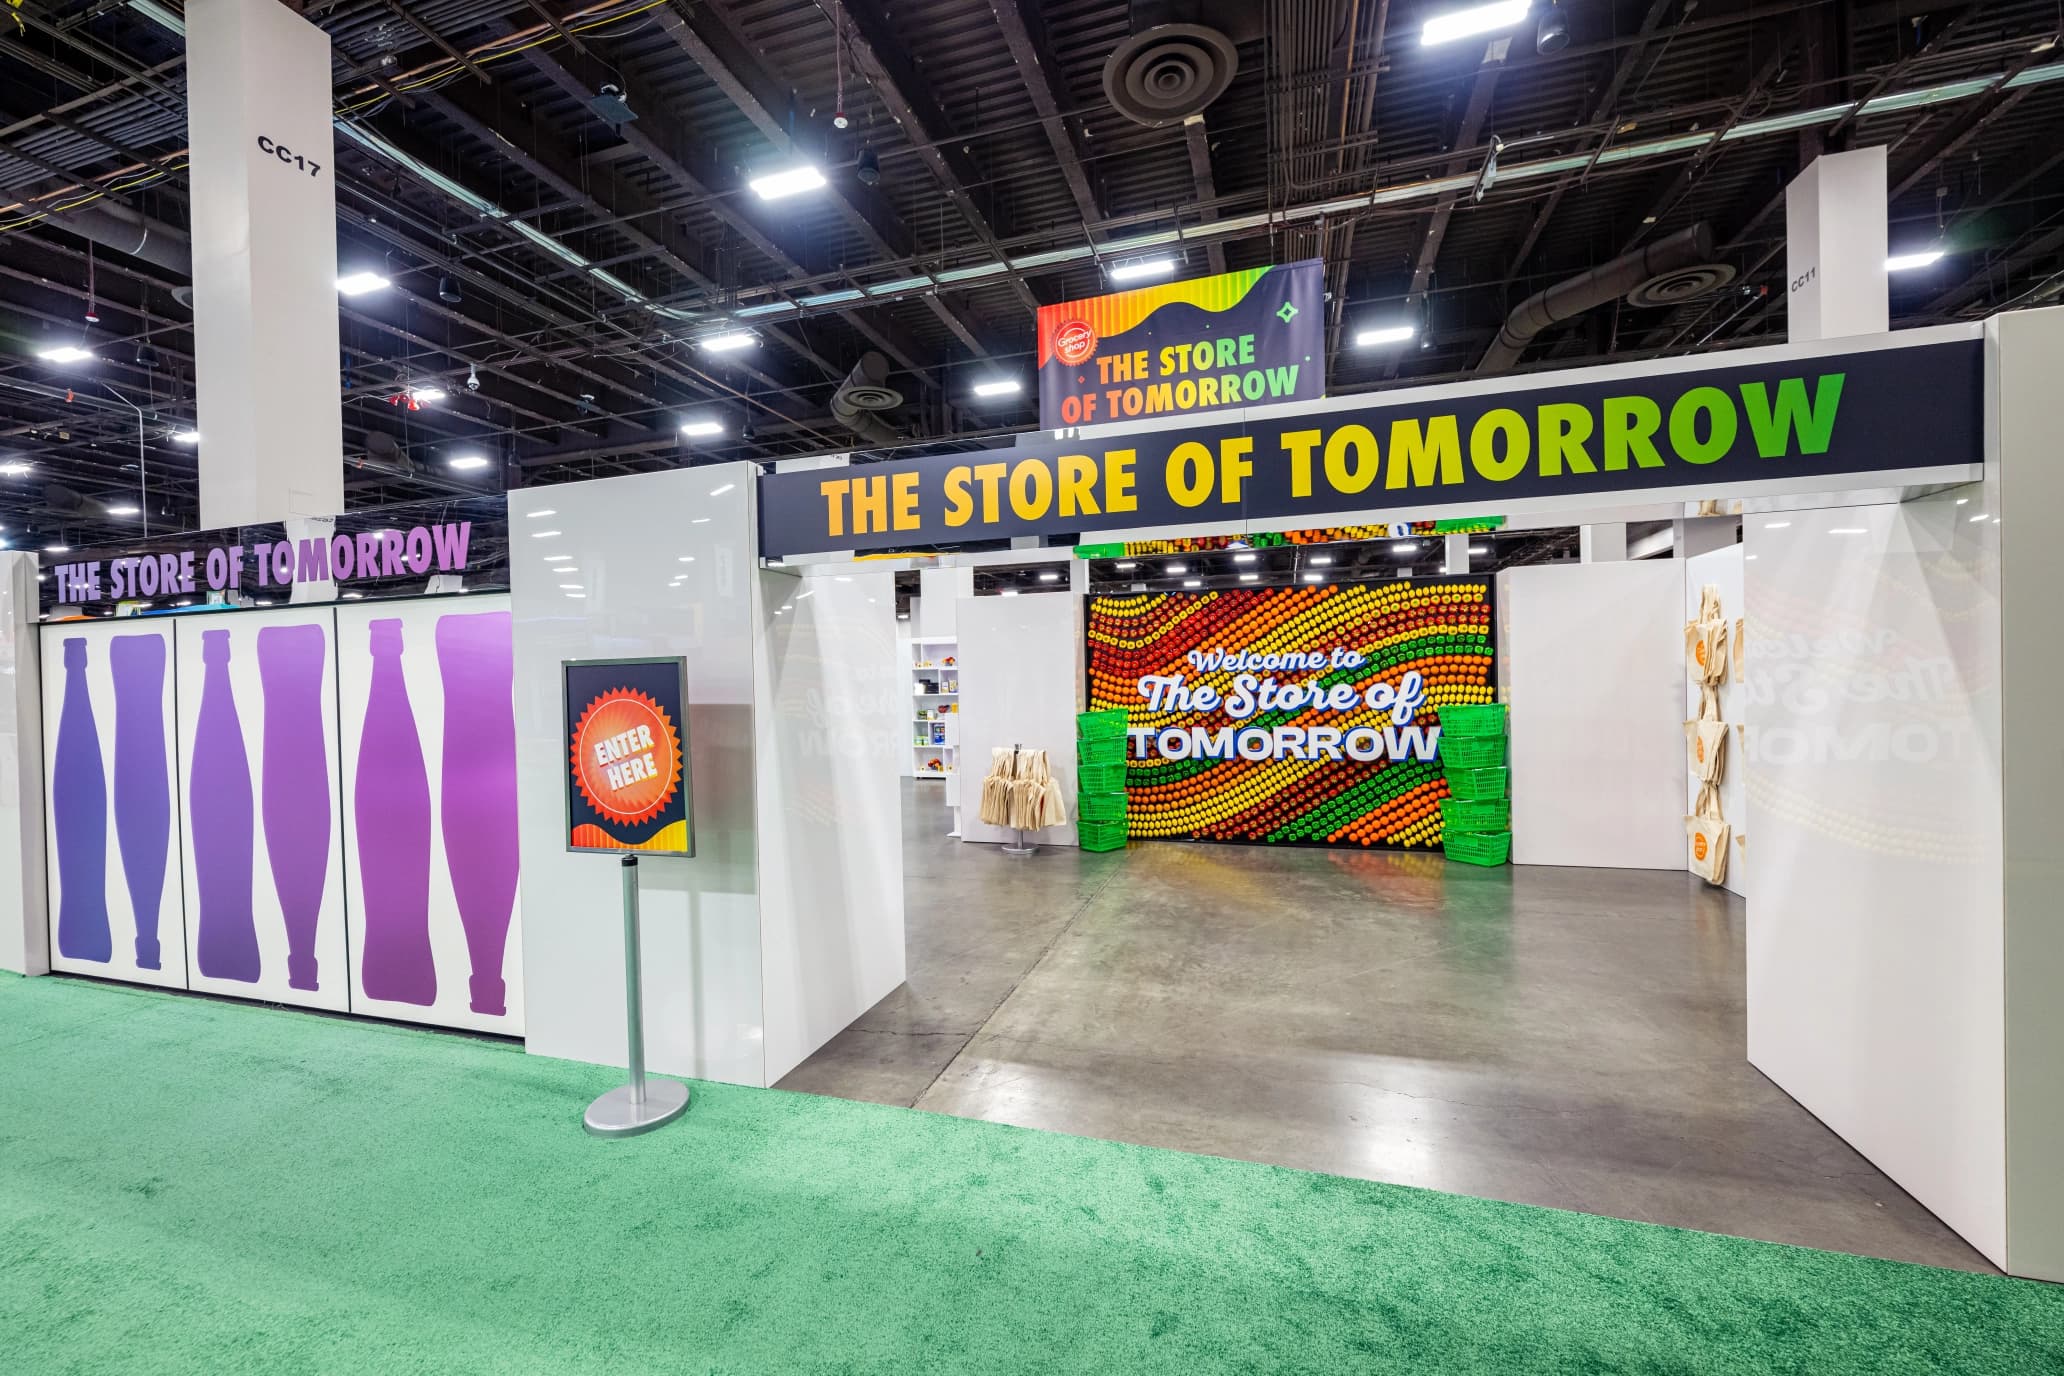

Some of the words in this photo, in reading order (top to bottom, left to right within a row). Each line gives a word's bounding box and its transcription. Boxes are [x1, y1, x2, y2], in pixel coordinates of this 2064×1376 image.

[257, 135, 321, 177] CC17
[1791, 266, 1816, 293] CC11
[1057, 327, 1093, 347] Grocery
[1064, 340, 1086, 354] shop
[1096, 350, 1149, 385] THE
[1159, 334, 1255, 376] STORE
[1061, 393, 1097, 425] OF
[1106, 364, 1299, 419] TOMORROW
[820, 471, 921, 537] THE
[943, 448, 1138, 527] STORE
[1165, 436, 1253, 508] OF
[1280, 372, 1846, 498] TOMORROW
[54, 561, 101, 603] THE
[110, 551, 196, 599] STORE
[206, 545, 244, 590] OF
[254, 521, 472, 586] TOMORROW
[1187, 647, 1329, 673] Welcome
[1330, 646, 1367, 670] to
[1137, 673, 1222, 713] The
[1225, 673, 1360, 719] Store
[1365, 670, 1428, 727] of
[593, 724, 655, 767] ENTER
[1127, 725, 1443, 762] TOMORROW
[607, 752, 658, 792] HERE
